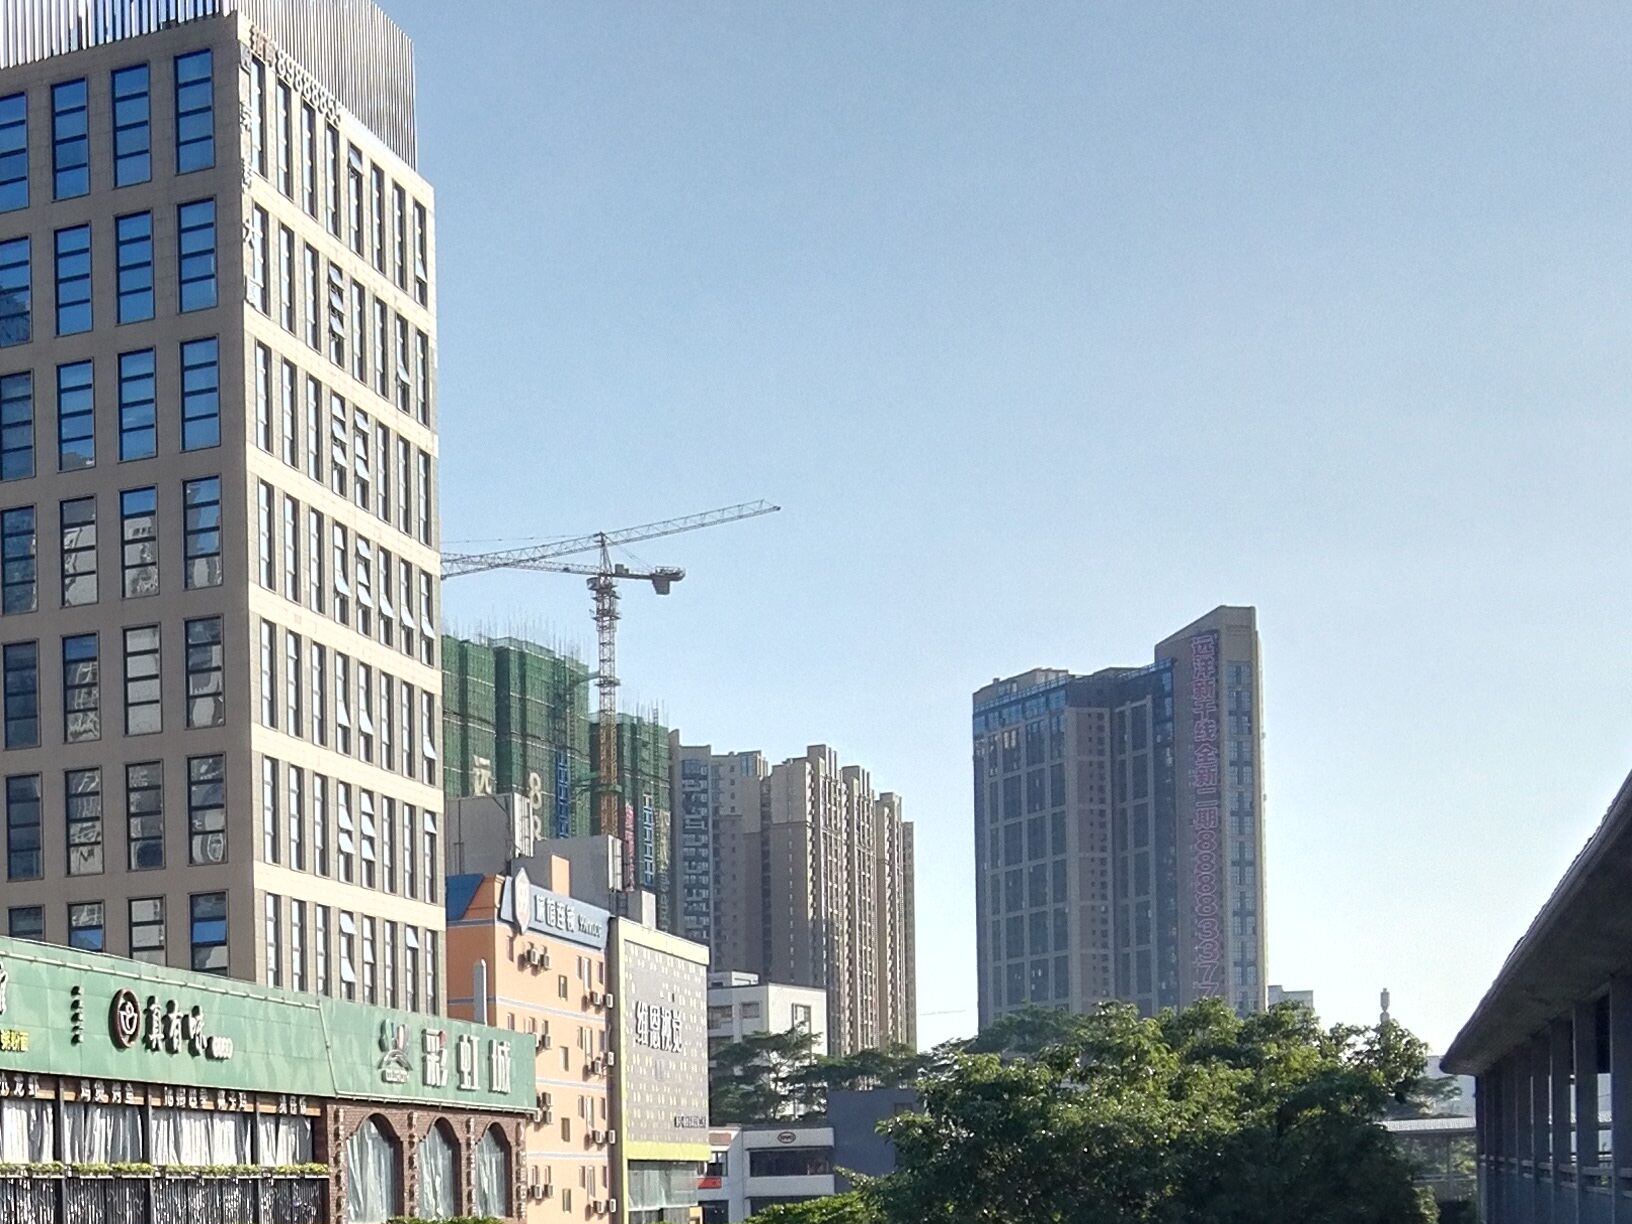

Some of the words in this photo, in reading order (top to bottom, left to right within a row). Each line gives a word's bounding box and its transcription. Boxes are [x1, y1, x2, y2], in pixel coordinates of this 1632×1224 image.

[636, 1000, 683, 1053] 维恩视觉
[426, 1028, 511, 1094] 彩虹城
